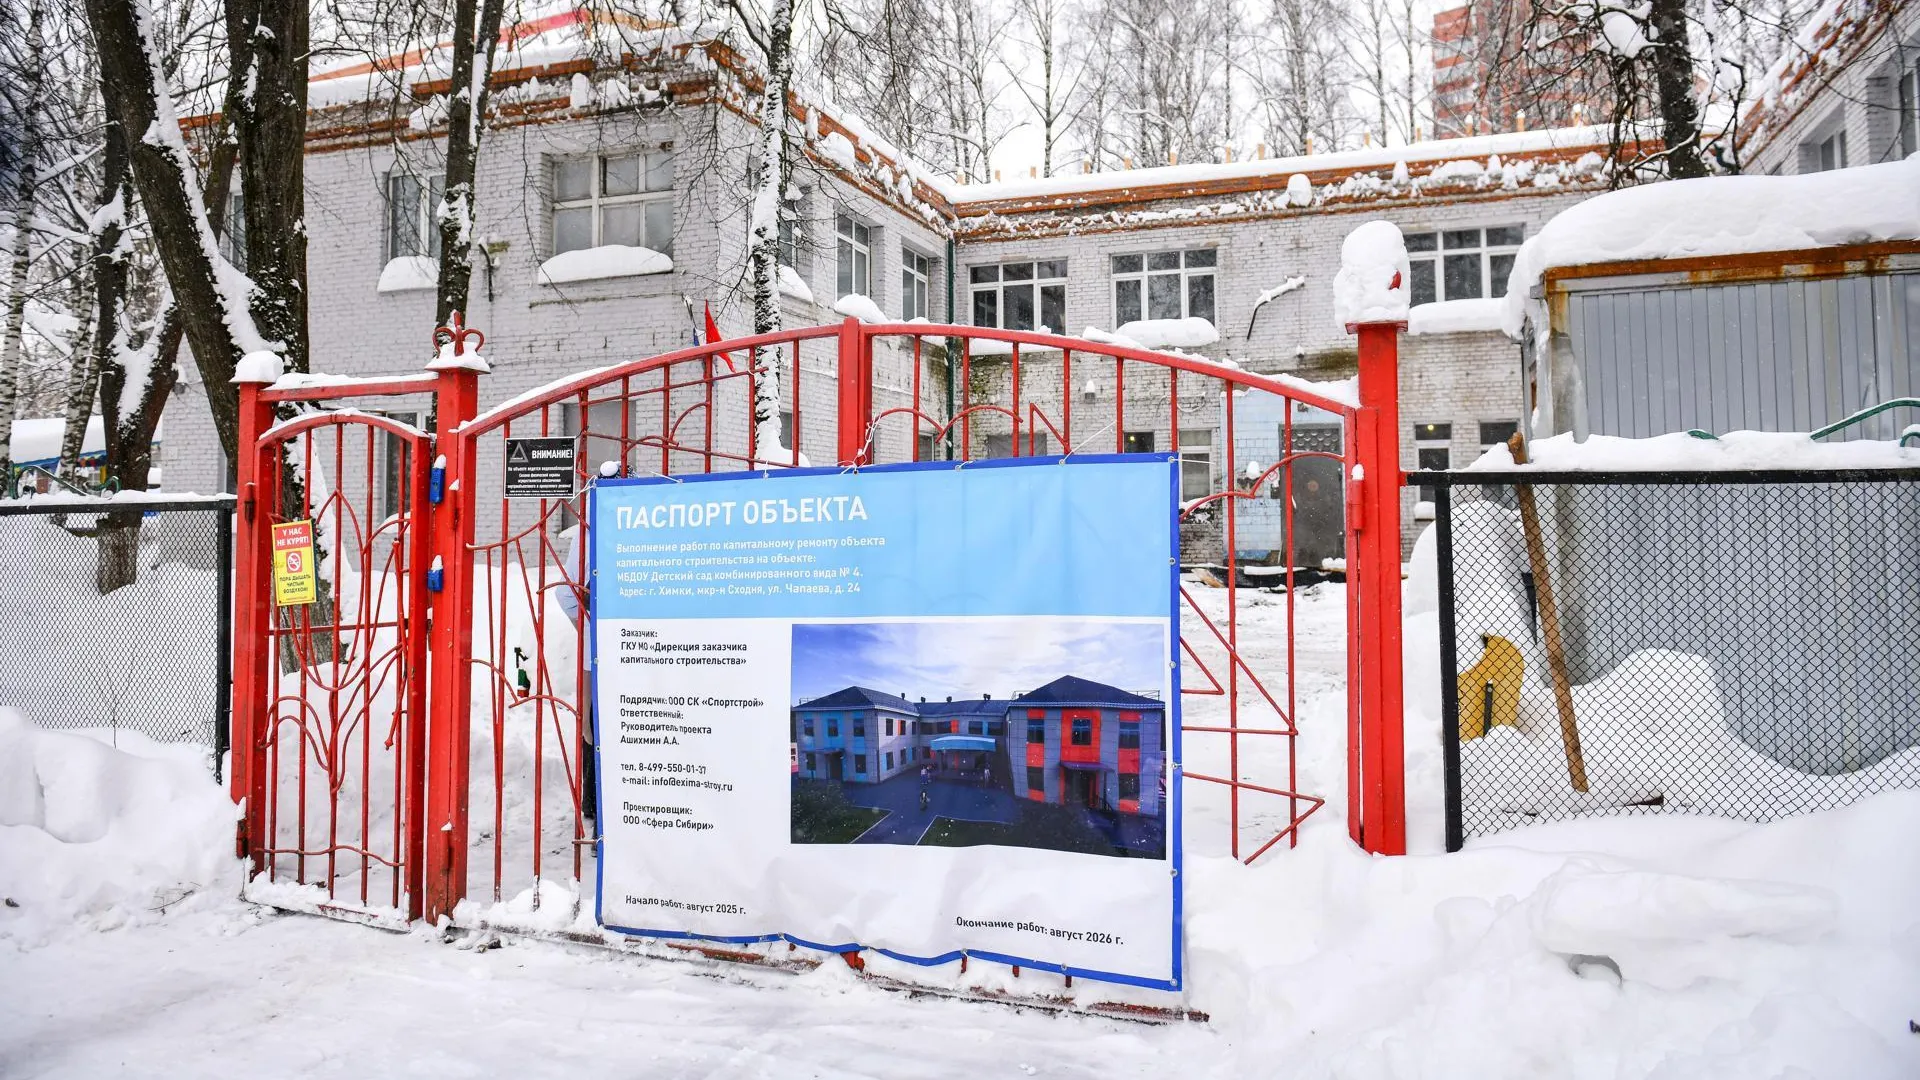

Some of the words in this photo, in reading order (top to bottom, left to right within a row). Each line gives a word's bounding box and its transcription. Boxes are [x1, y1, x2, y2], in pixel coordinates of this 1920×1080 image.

[531, 449, 573, 459] ВНИМАНИЕ!
[616, 502, 737, 530] ПАСПОРТ
[743, 496, 868, 525] ОБЪЕКТА
[282, 529, 288, 537] У
[288, 528, 303, 536] НАС
[276, 539, 286, 547] НЕ
[286, 536, 309, 545] КУРЯТ!
[616, 543, 678, 553] Выполнение
[680, 542, 707, 553] работ
[710, 542, 721, 550] по
[724, 539, 794, 551] капитальному
[797, 538, 838, 551] ремонту
[840, 536, 886, 547] объекта
[616, 558, 682, 568] капитального
[685, 556, 754, 568] строительства
[756, 555, 769, 564] на
[770, 553, 817, 564] объекте:
[617, 571, 649, 584] МБДОУ
[651, 570, 693, 583] Детский
[696, 572, 713, 582] сад
[714, 569, 811, 580] комбинированного
[813, 569, 837, 580] вида
[839, 567, 850, 577] №
[852, 566, 864, 577] 4.
[619, 587, 647, 598] Адрес:
[649, 588, 656, 596] г.
[658, 586, 694, 596] Химки,
[697, 587, 726, 597] мкр-н
[727, 584, 766, 595] Сходня,
[768, 586, 782, 596] ул.
[785, 583, 833, 594] Чапаева,
[834, 584, 844, 594] д.
[847, 582, 860, 593] 24
[621, 628, 658, 638] Заказчик:
[621, 641, 636, 650] ГКУ
[638, 642, 649, 651] МО
[650, 642, 700, 653] «Дирекция
[702, 643, 747, 651] заказчика
[620, 656, 673, 665] капитального
[676, 656, 747, 666] строительства»
[620, 694, 668, 706] Подрядчик:
[668, 696, 685, 706] ООО
[687, 697, 700, 706] СК
[702, 697, 764, 709] «Спортстрой»
[620, 708, 684, 720] Ответственный:
[621, 721, 678, 733] Руководитель
[680, 725, 712, 735] проекта
[620, 735, 661, 745] Ашихмин
[663, 736, 680, 745] А.А.
[621, 763, 636, 771] тел.
[622, 777, 650, 786] e-mail:
[652, 777, 733, 792] info@exima-stroy.ru
[623, 801, 693, 815] Проектировщик:
[623, 815, 640, 825] ООО
[642, 817, 673, 830] «Сфера
[676, 819, 714, 831] Сибири»
[625, 895, 659, 905] Начало
[660, 899, 685, 909] работ:
[686, 903, 714, 913] август
[716, 904, 737, 914] 2025
[739, 906, 746, 915] г.
[956, 916, 1014, 929] Окончание
[1017, 921, 1048, 935] работ:
[1050, 928, 1084, 941] август
[1086, 932, 1112, 944] 2026
[1115, 936, 1124, 945] г.
